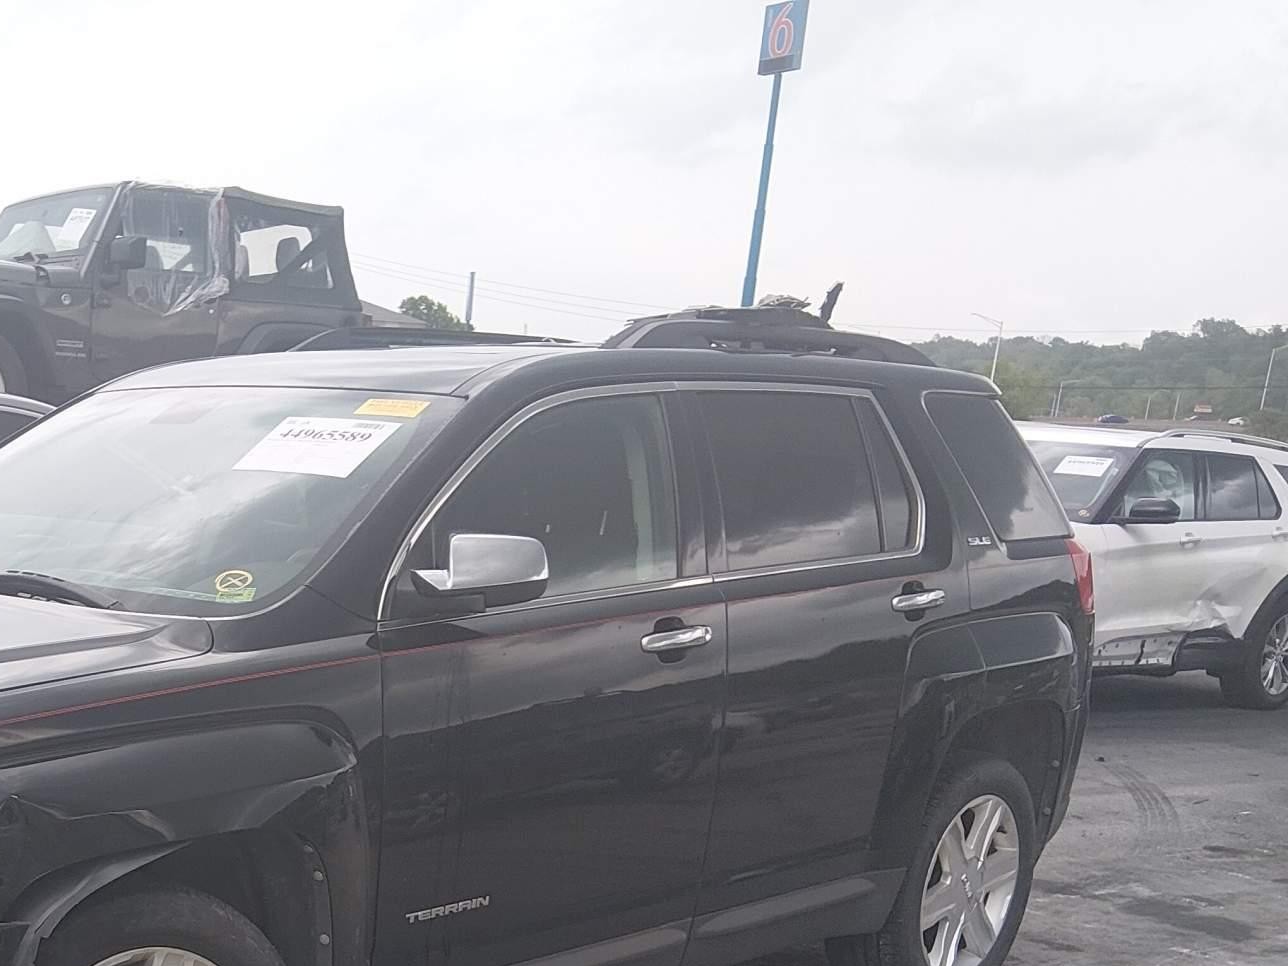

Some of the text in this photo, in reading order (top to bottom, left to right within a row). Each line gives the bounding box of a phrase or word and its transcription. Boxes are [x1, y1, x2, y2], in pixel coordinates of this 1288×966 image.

[768, 2, 794, 58] 6
[279, 428, 373, 442] 44965589
[405, 895, 490, 924] TERRAIN
